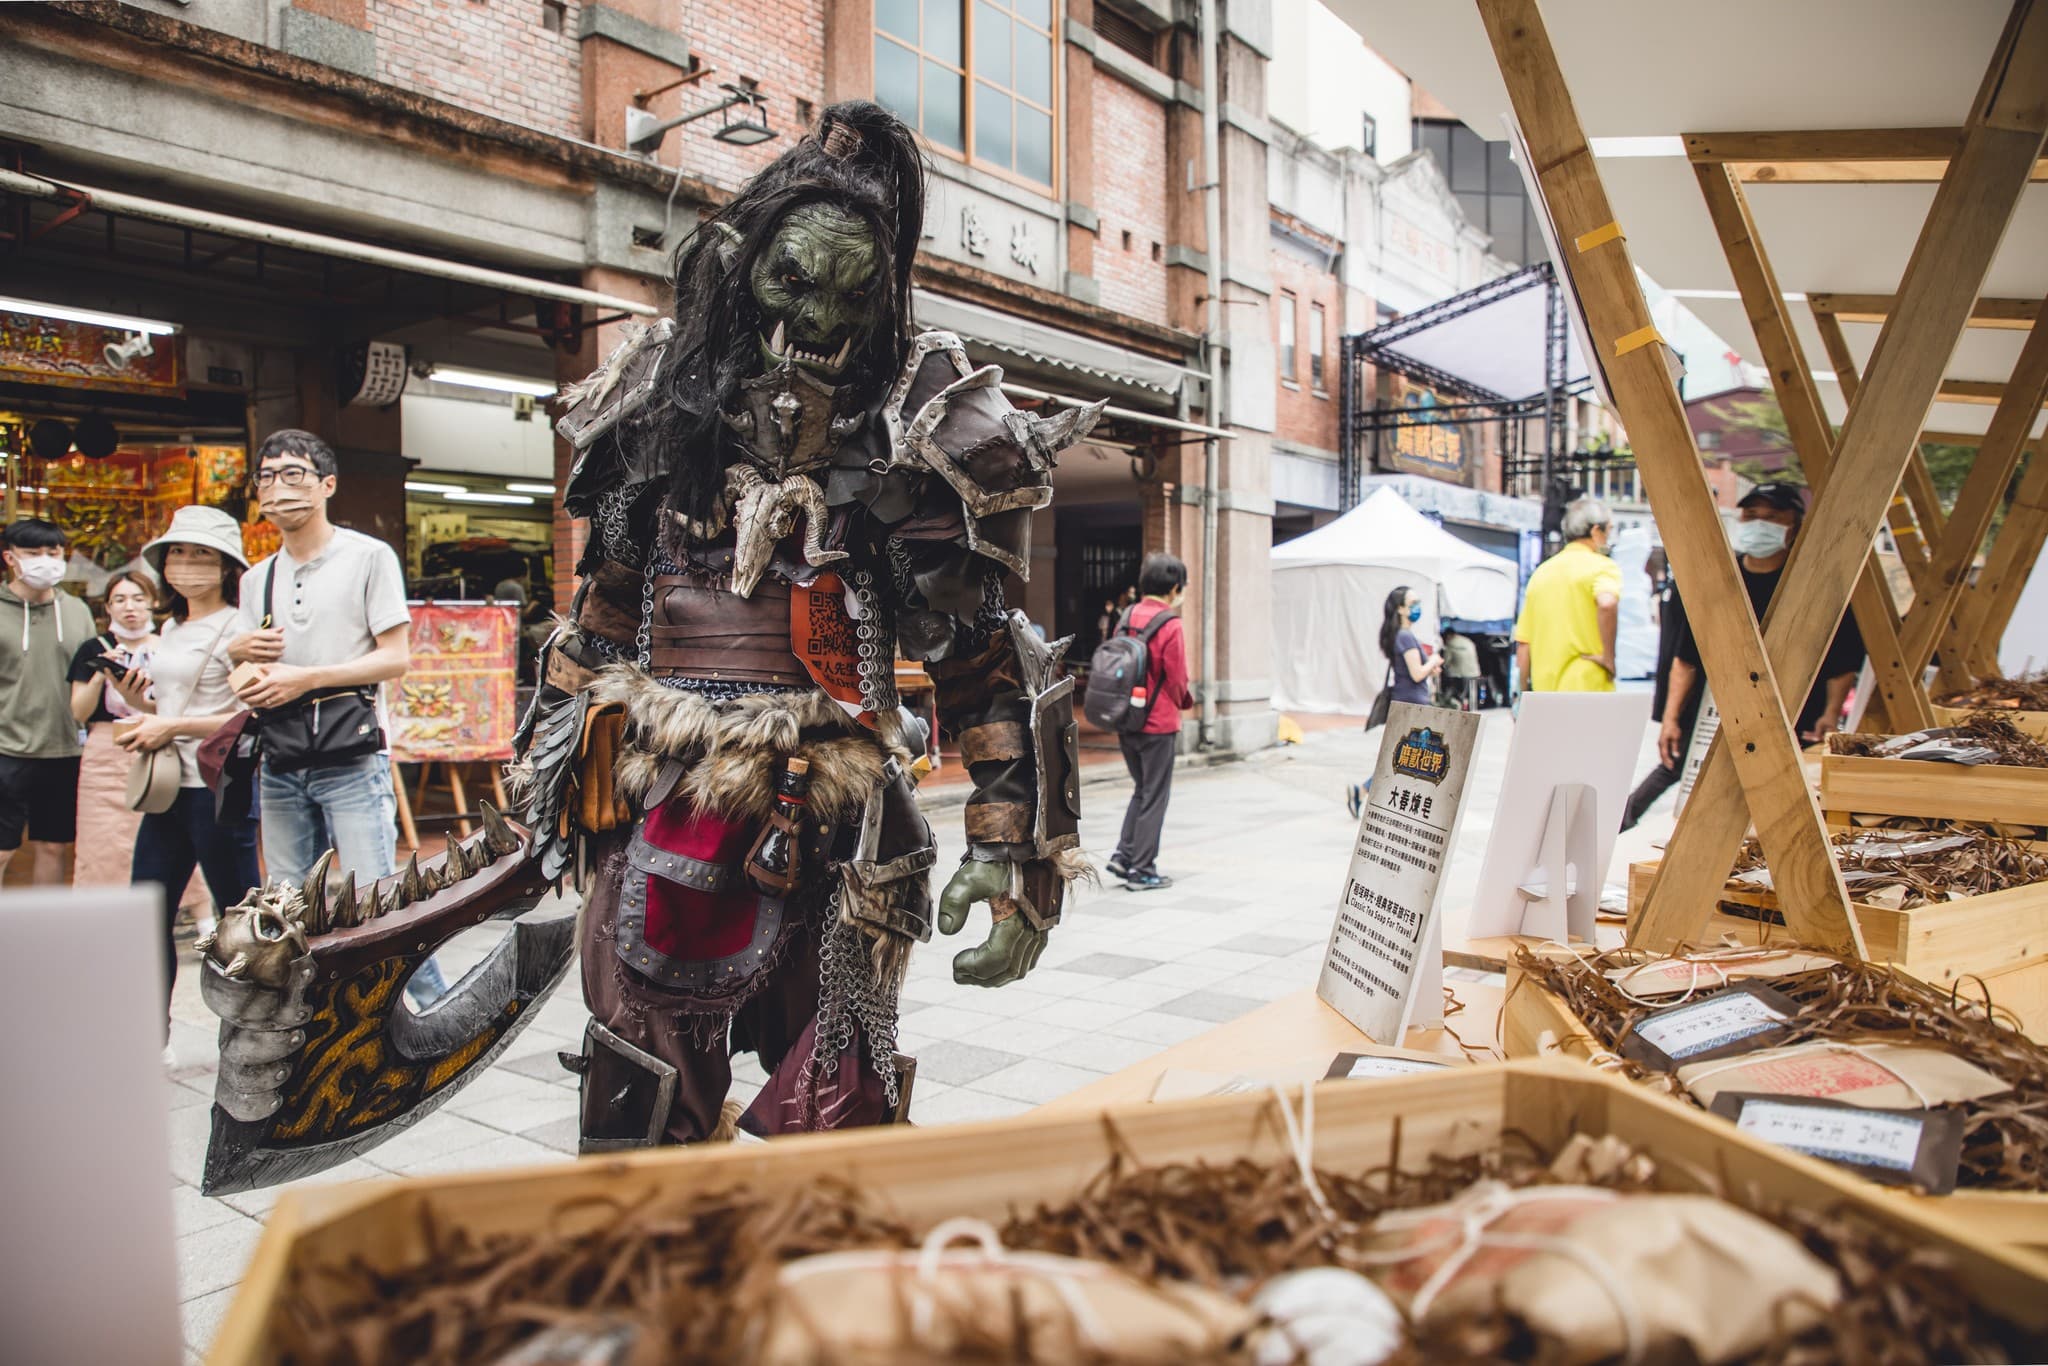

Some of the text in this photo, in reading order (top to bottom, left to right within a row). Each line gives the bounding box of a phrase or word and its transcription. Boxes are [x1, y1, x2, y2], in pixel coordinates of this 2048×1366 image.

[1398, 743, 1444, 774] 魔獸世界
[1388, 785, 1433, 820] 大春煉皂
[1350, 897, 1413, 939] Classic Tea Soap For Travel
